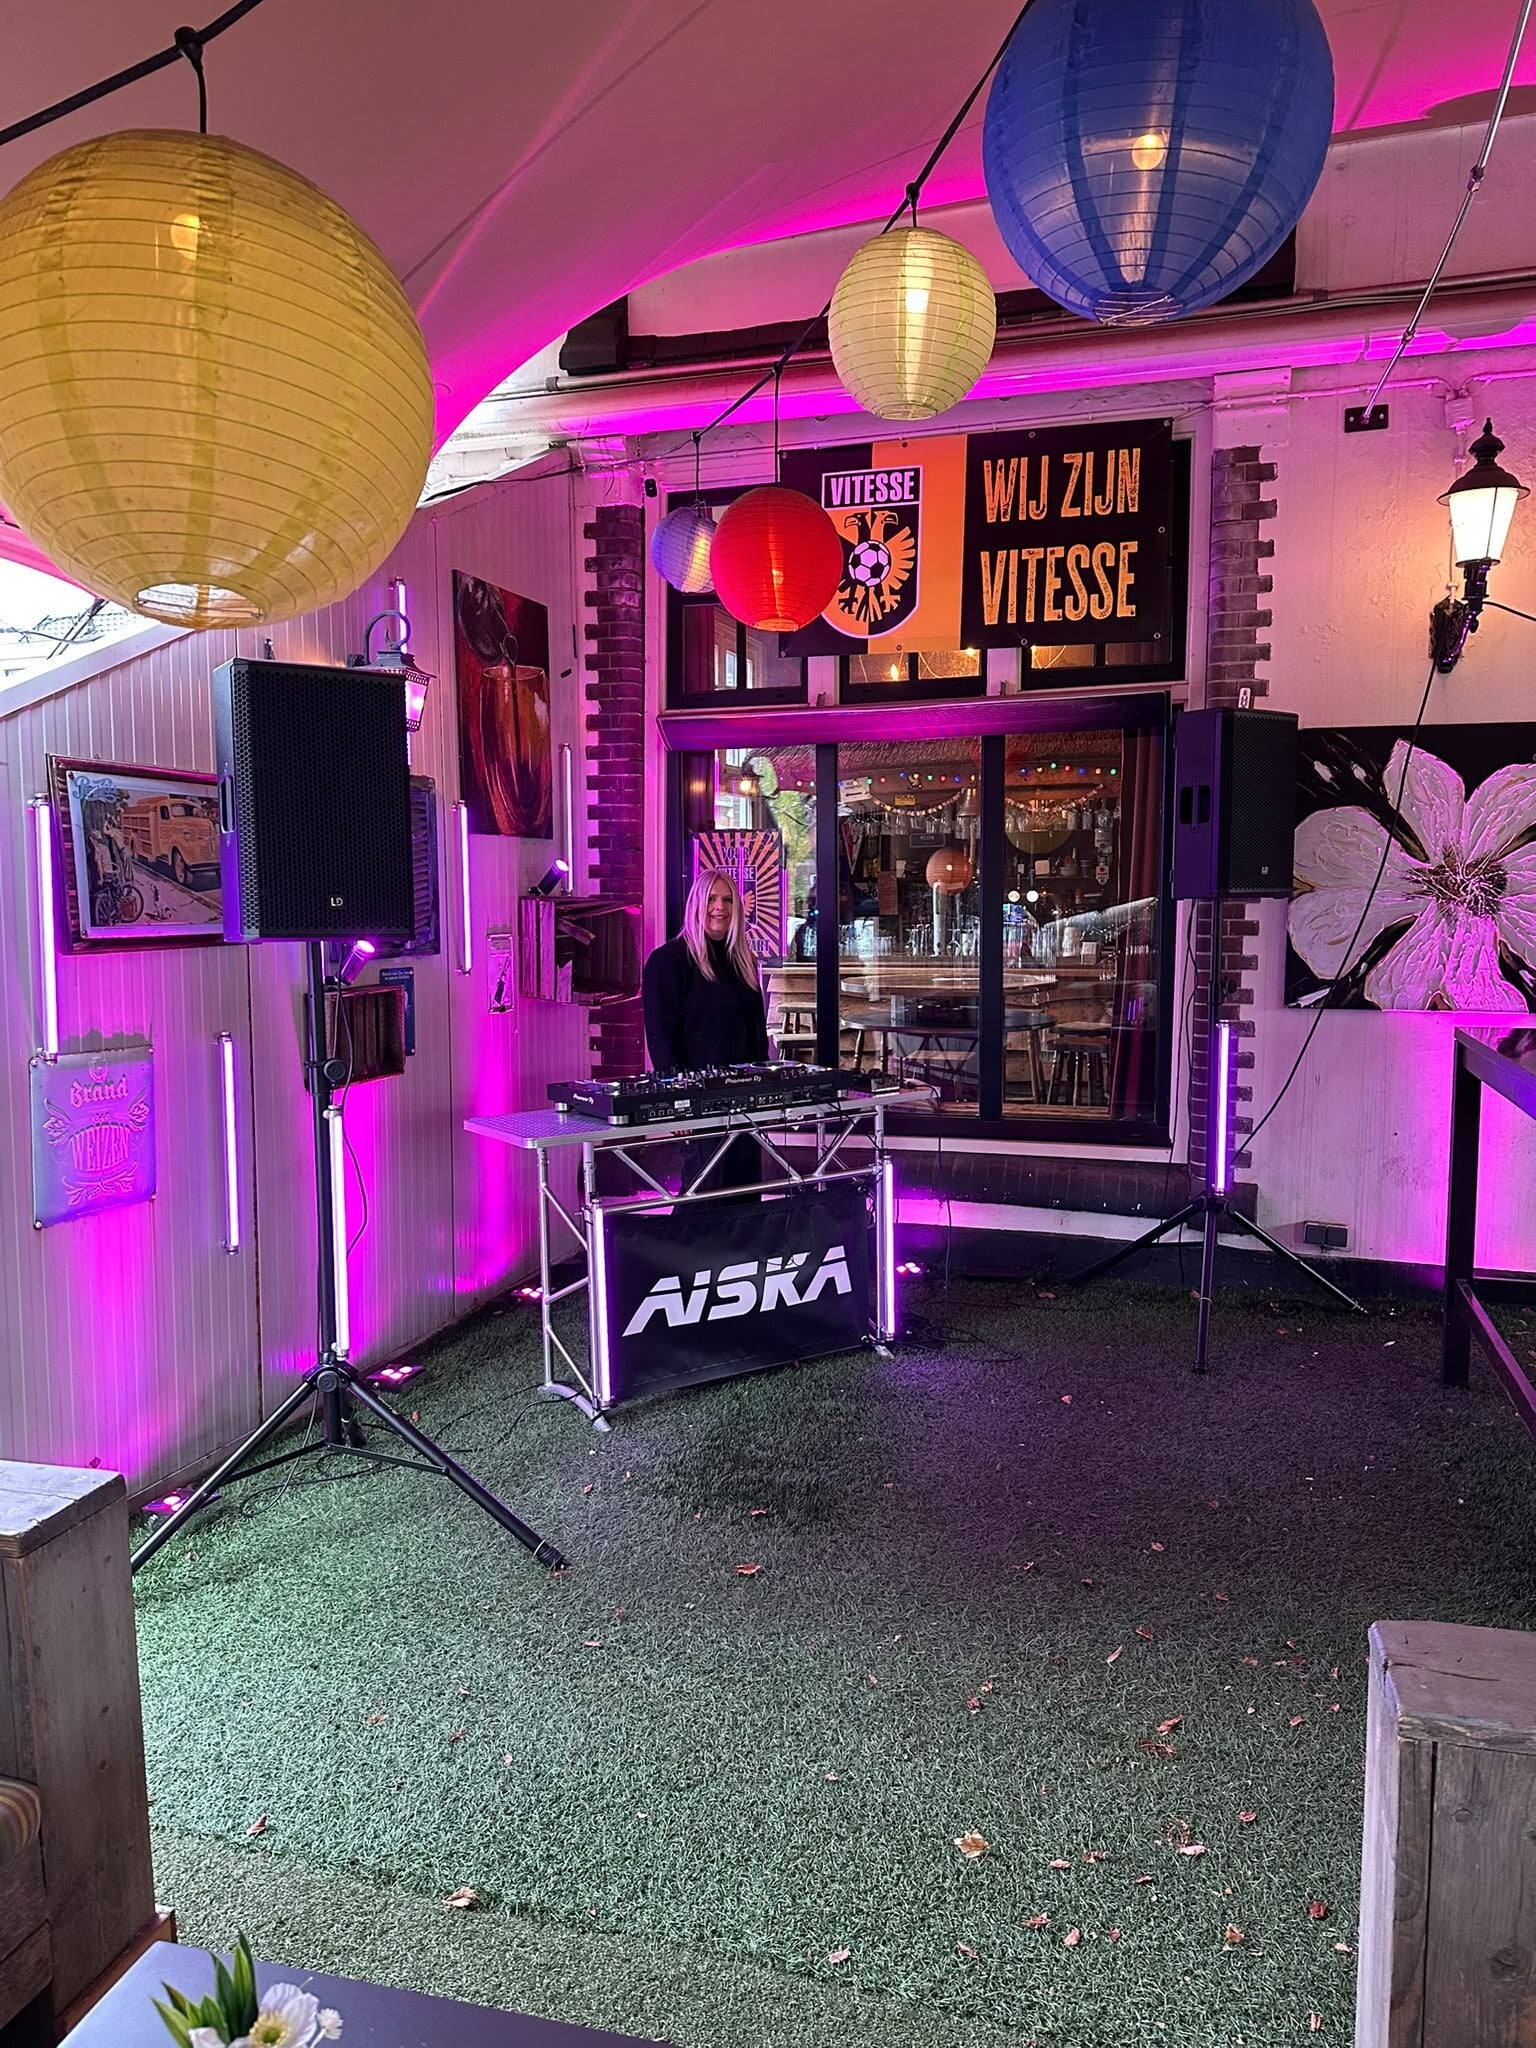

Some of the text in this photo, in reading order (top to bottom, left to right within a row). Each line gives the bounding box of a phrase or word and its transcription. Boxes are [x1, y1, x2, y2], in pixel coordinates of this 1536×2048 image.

[831, 471, 914, 505] VITESSE
[984, 448, 1140, 523] WIJ ZIJN
[981, 541, 1138, 625] VITESSE
[330, 897, 343, 906] LD
[70, 1074, 129, 1108] Brand
[70, 1123, 132, 1171] WEIZEN
